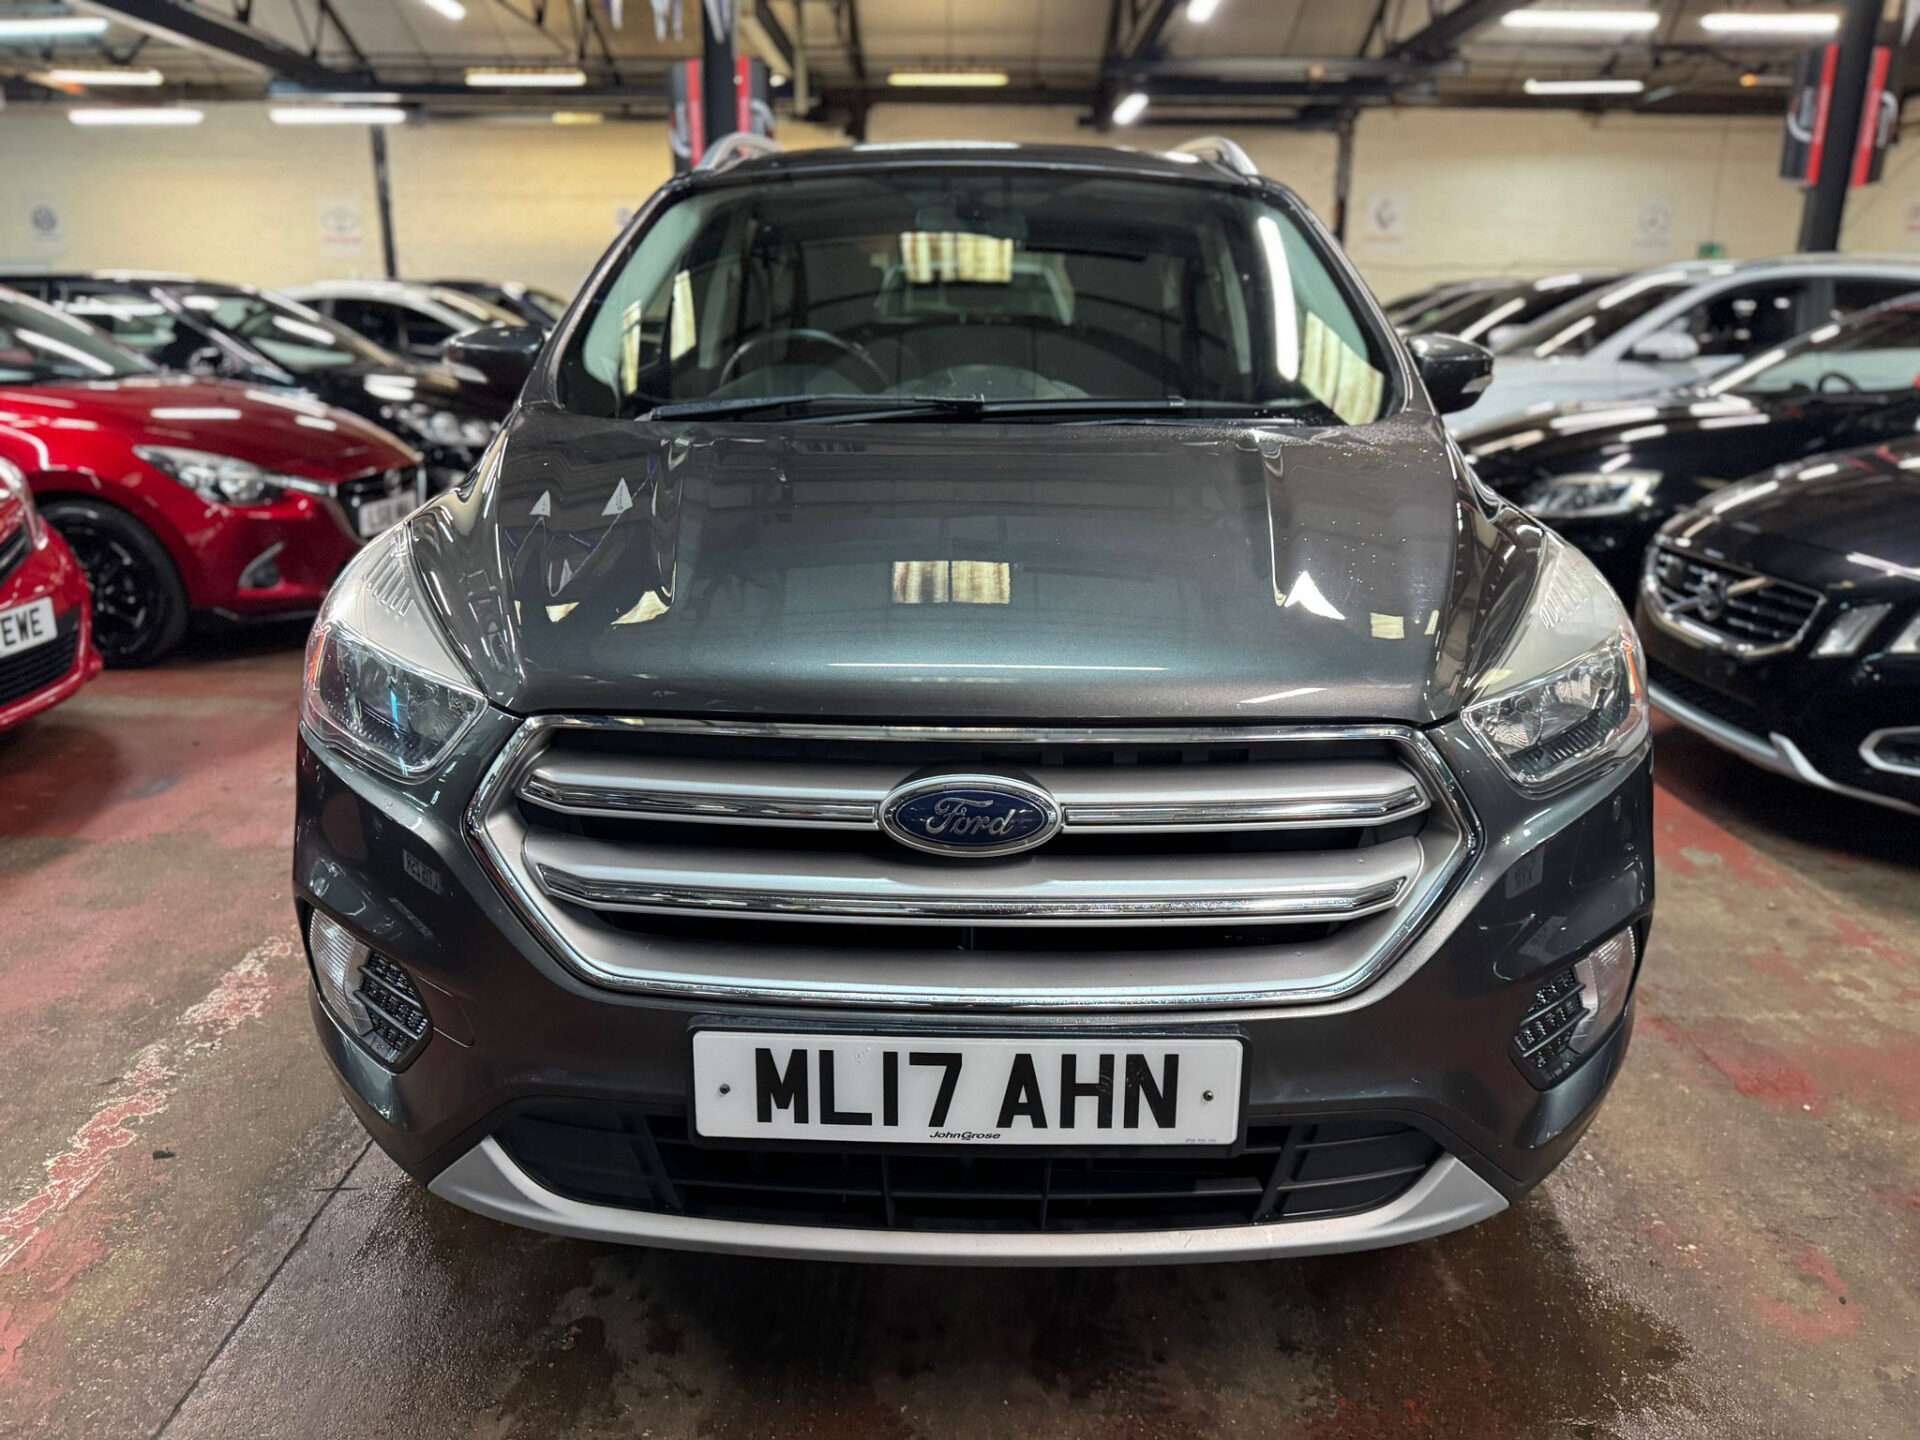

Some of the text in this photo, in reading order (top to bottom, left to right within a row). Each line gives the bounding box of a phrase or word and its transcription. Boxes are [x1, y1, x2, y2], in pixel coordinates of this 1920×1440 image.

[0, 606, 44, 647] EWE
[925, 796, 1016, 836] Ford
[754, 1047, 1180, 1129] ML17 AHN
